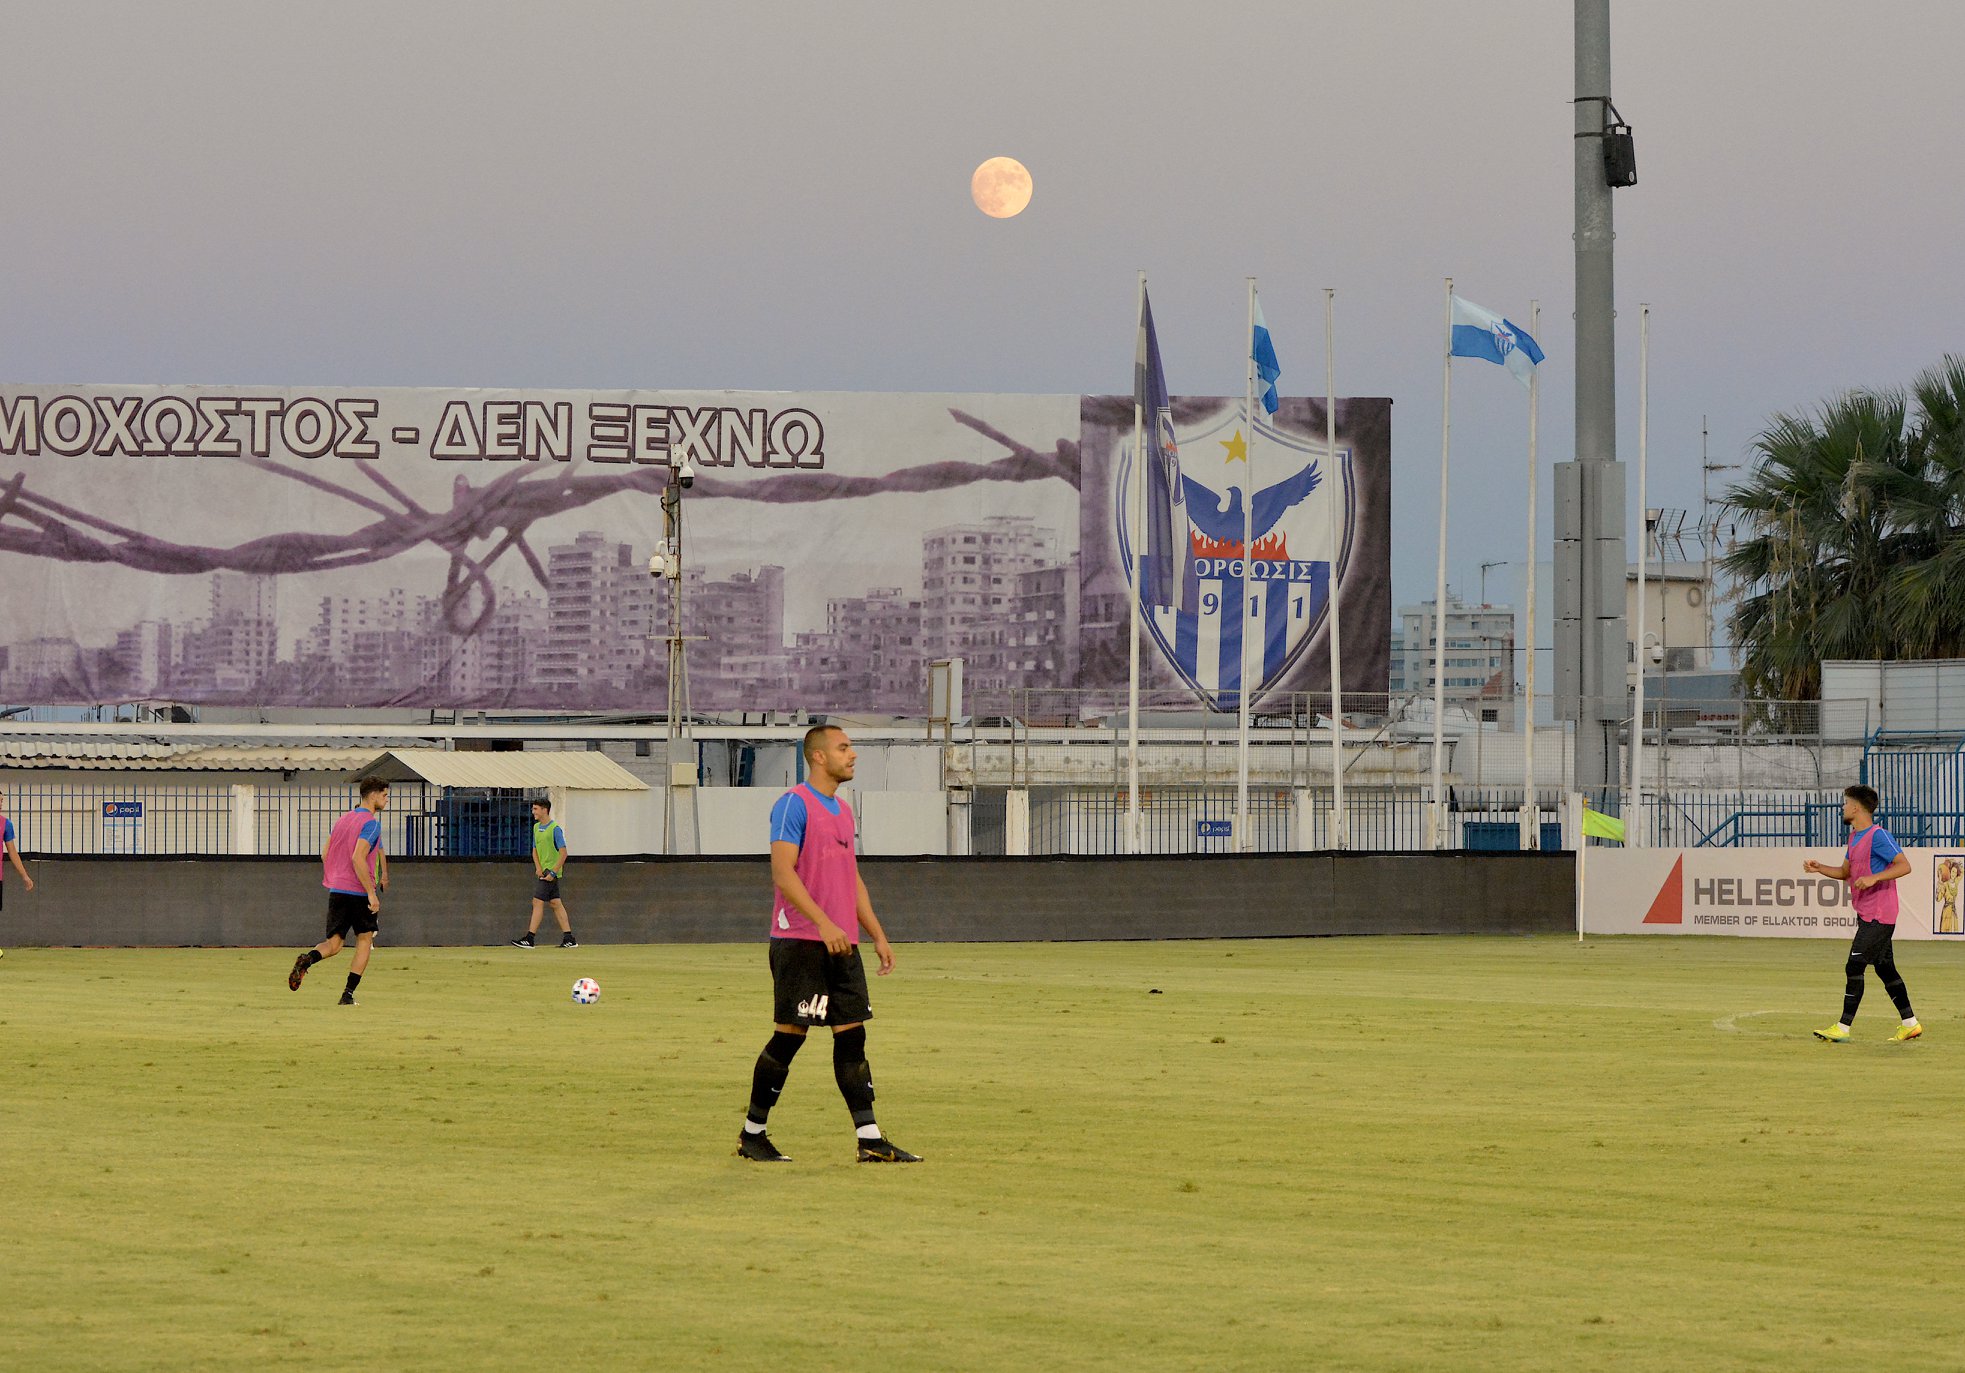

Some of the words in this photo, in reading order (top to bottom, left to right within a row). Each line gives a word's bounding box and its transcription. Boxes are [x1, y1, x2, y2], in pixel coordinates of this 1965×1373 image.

[392, 427, 419, 443] -
[430, 401, 572, 462] ΔΕΝ
[587, 403, 825, 469] ΞΕΧΝΩ
[1694, 915, 1740, 925] MEMBER
[1744, 915, 1758, 925] OF
[1762, 916, 1818, 927] ELLAKTOR
[808, 993, 829, 1020] 44
